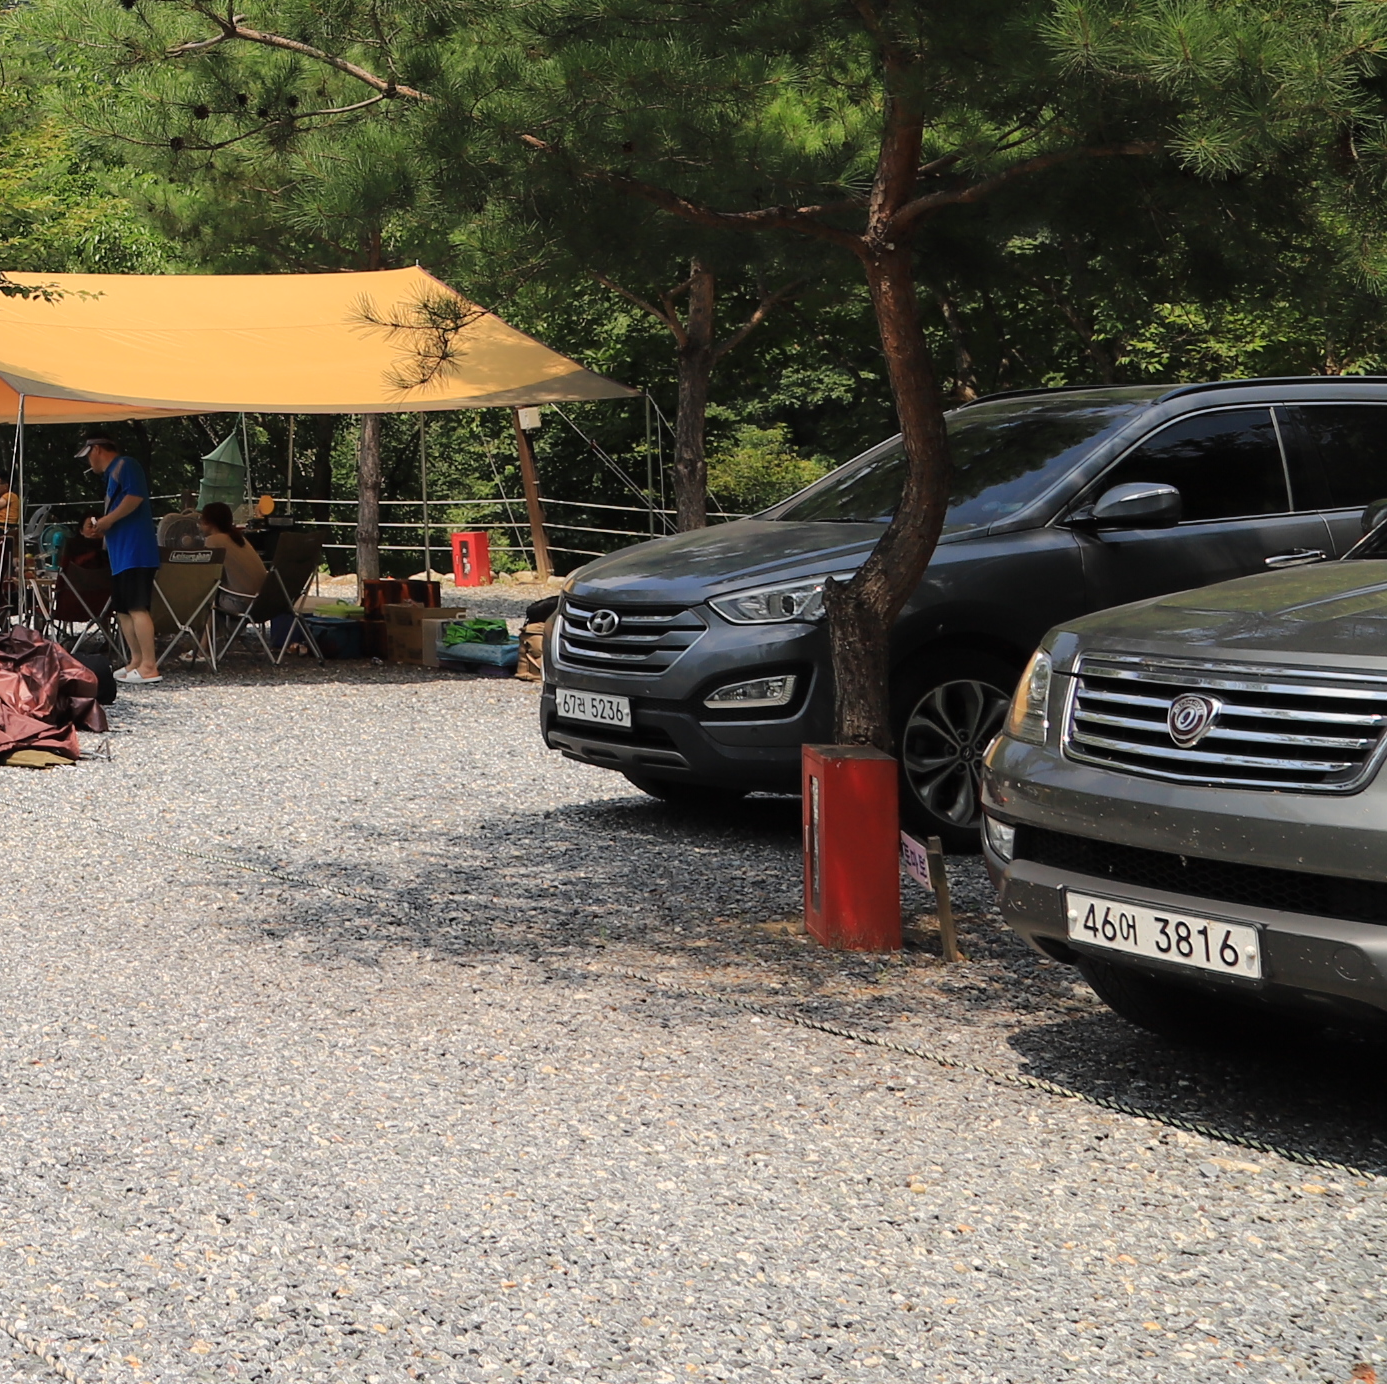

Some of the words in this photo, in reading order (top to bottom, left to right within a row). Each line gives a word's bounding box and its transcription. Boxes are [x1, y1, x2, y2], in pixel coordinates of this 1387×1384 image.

[563, 694, 586, 715] 67러
[591, 698, 624, 722] 5236
[1083, 903, 1138, 946] 46어
[1154, 917, 1239, 967] 3816
